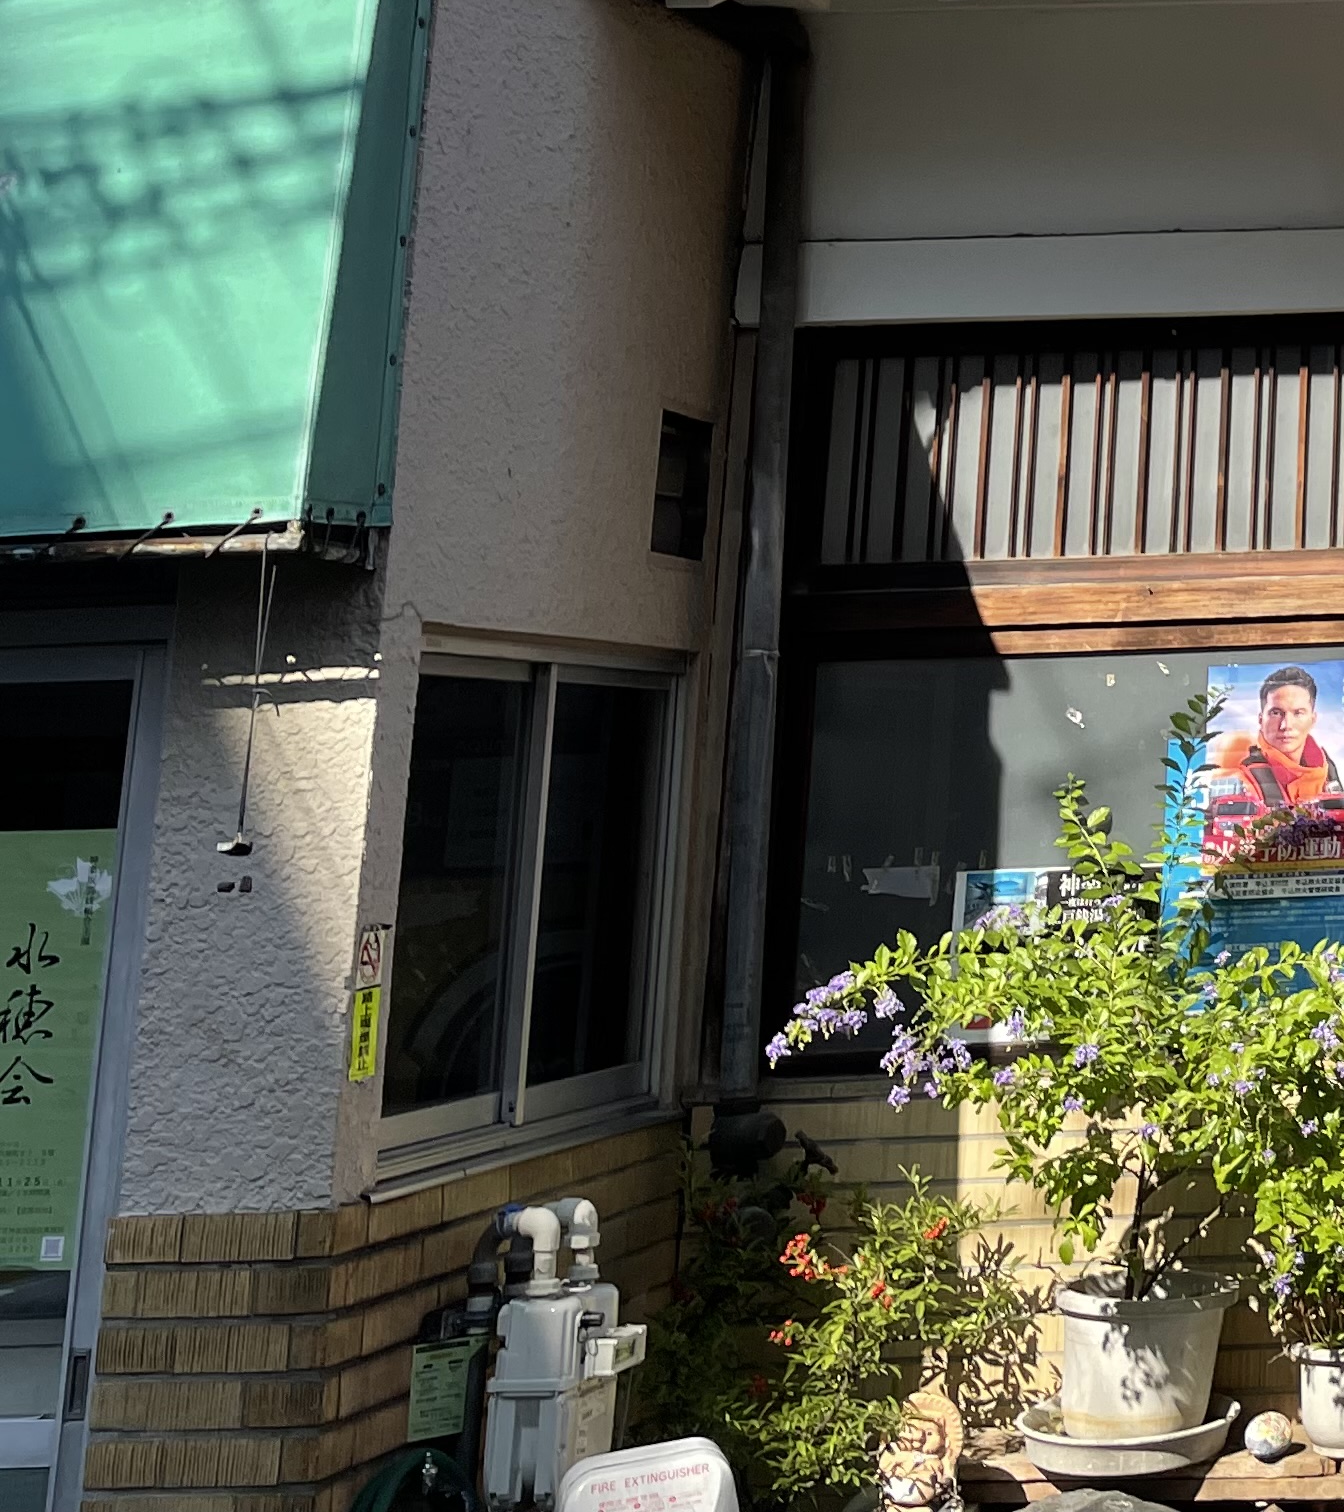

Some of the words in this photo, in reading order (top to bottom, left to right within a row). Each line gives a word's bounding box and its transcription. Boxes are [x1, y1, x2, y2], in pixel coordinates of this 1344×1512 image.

[1216, 836, 1341, 862] 火予防運動
[591, 1480, 616, 1494] FIRE
[624, 1463, 709, 1488] EXTINGUISHER
